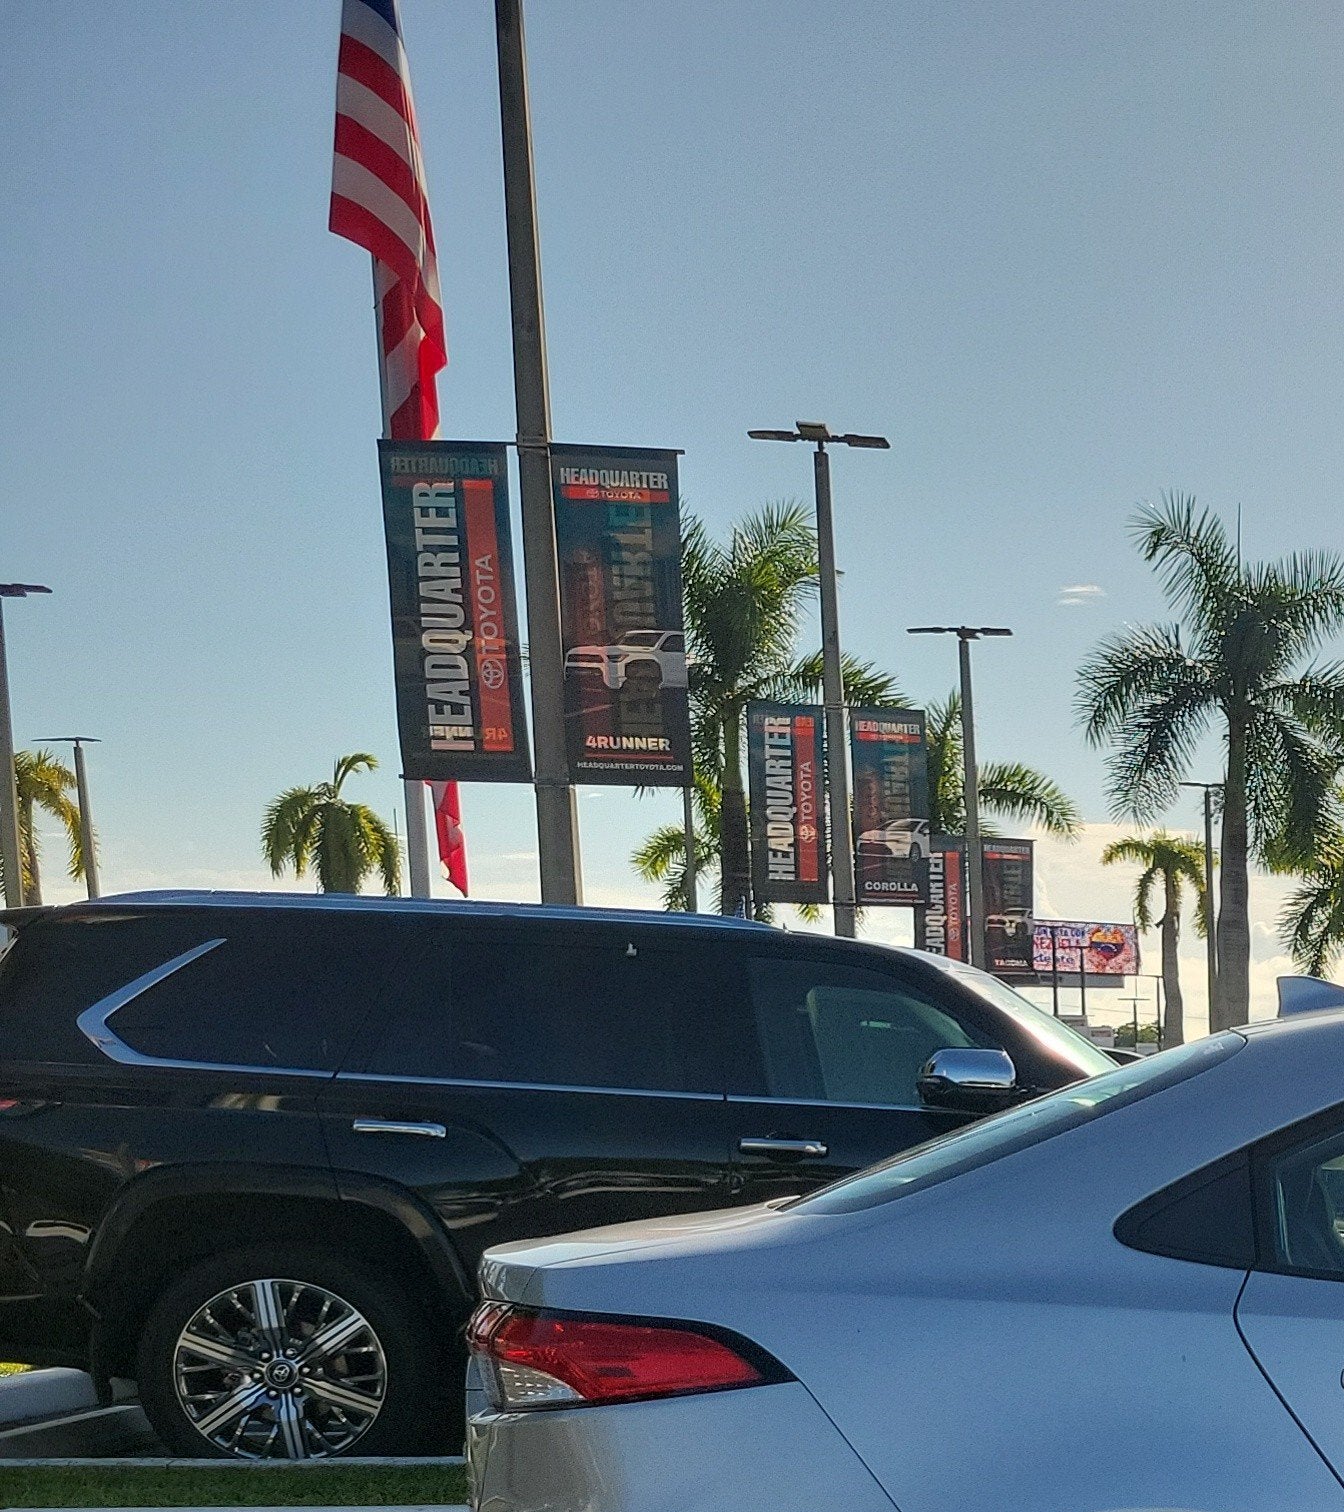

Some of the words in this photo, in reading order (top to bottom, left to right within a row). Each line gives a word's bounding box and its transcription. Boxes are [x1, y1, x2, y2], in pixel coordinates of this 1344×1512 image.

[560, 467, 668, 489] HEADQUARTER
[601, 490, 641, 500] TOYOTA
[412, 480, 475, 751] HEADQUARTER
[475, 554, 499, 656] TOYOTA
[585, 735, 671, 751] 4RUNNER
[764, 717, 796, 880] HEADQUARTER
[800, 761, 813, 821] TOYOTA
[864, 881, 919, 892] COROLLA
